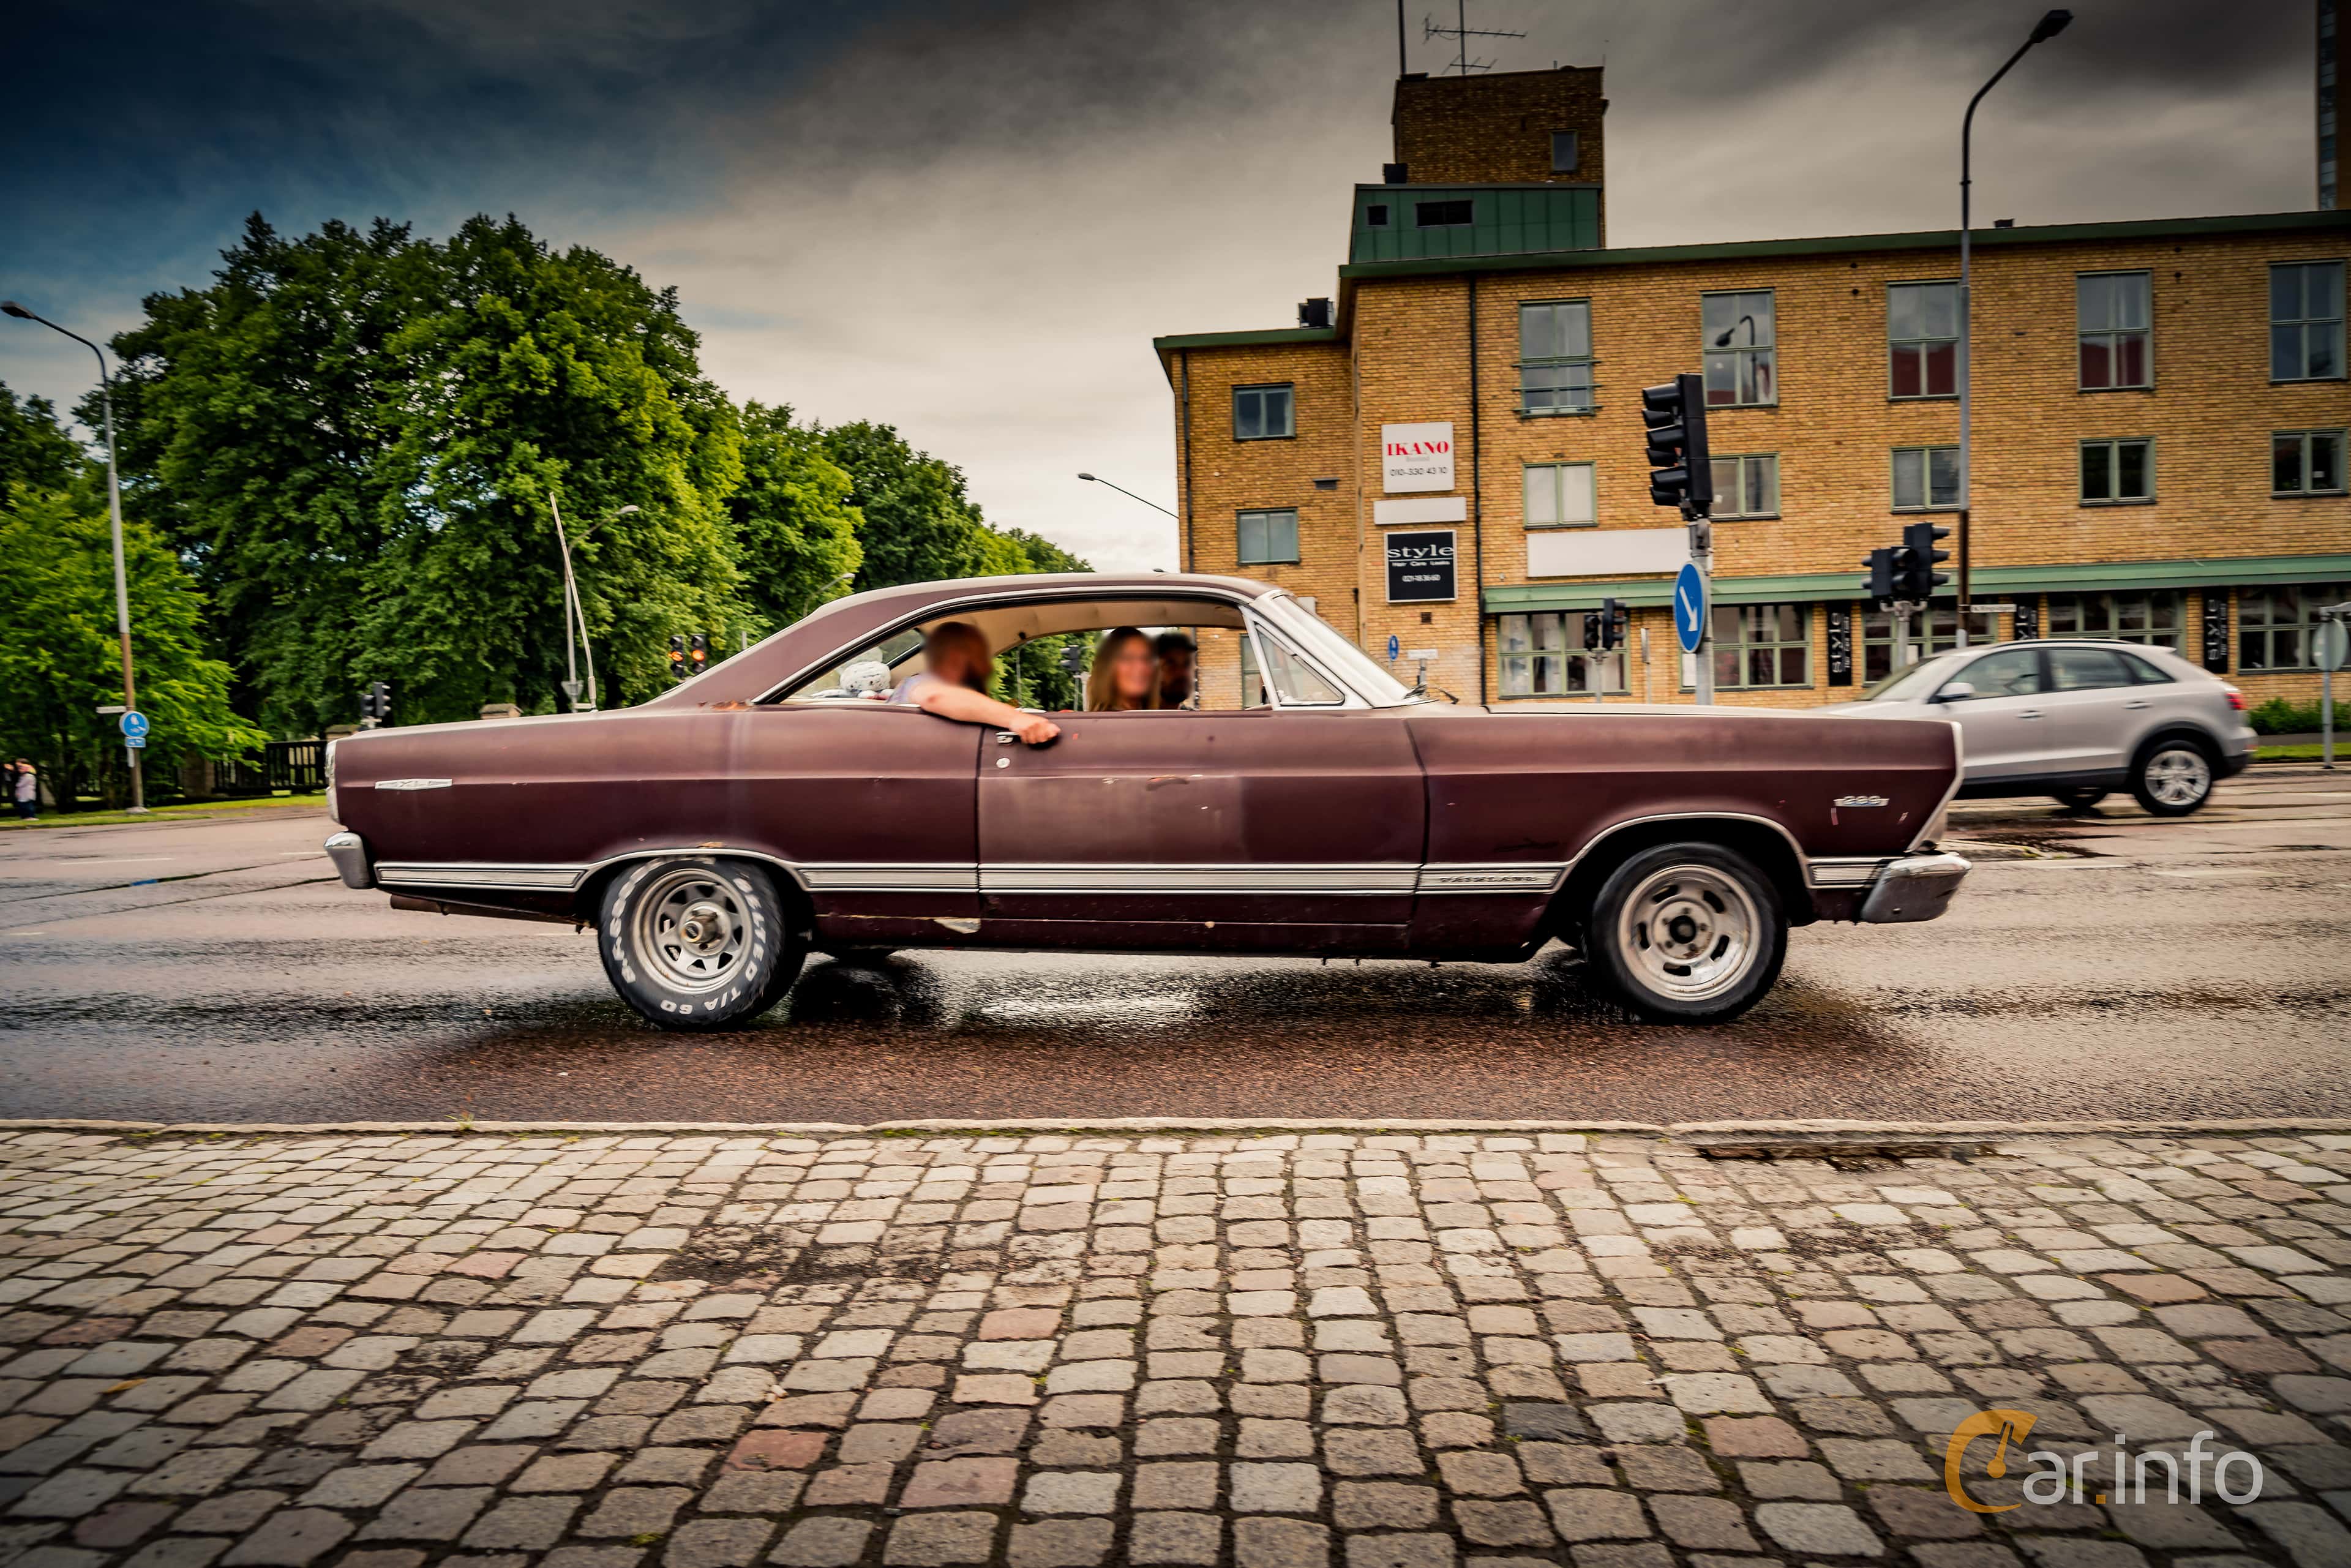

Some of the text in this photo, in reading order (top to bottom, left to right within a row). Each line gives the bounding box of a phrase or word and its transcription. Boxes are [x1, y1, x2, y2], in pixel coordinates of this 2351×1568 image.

[1387, 441, 1449, 456] IKANO
[1387, 544, 1455, 558] style
[2015, 606, 2028, 640] yle
[1829, 612, 1844, 673] style
[660, 999, 693, 1015] 60
[703, 986, 741, 1011] T/A
